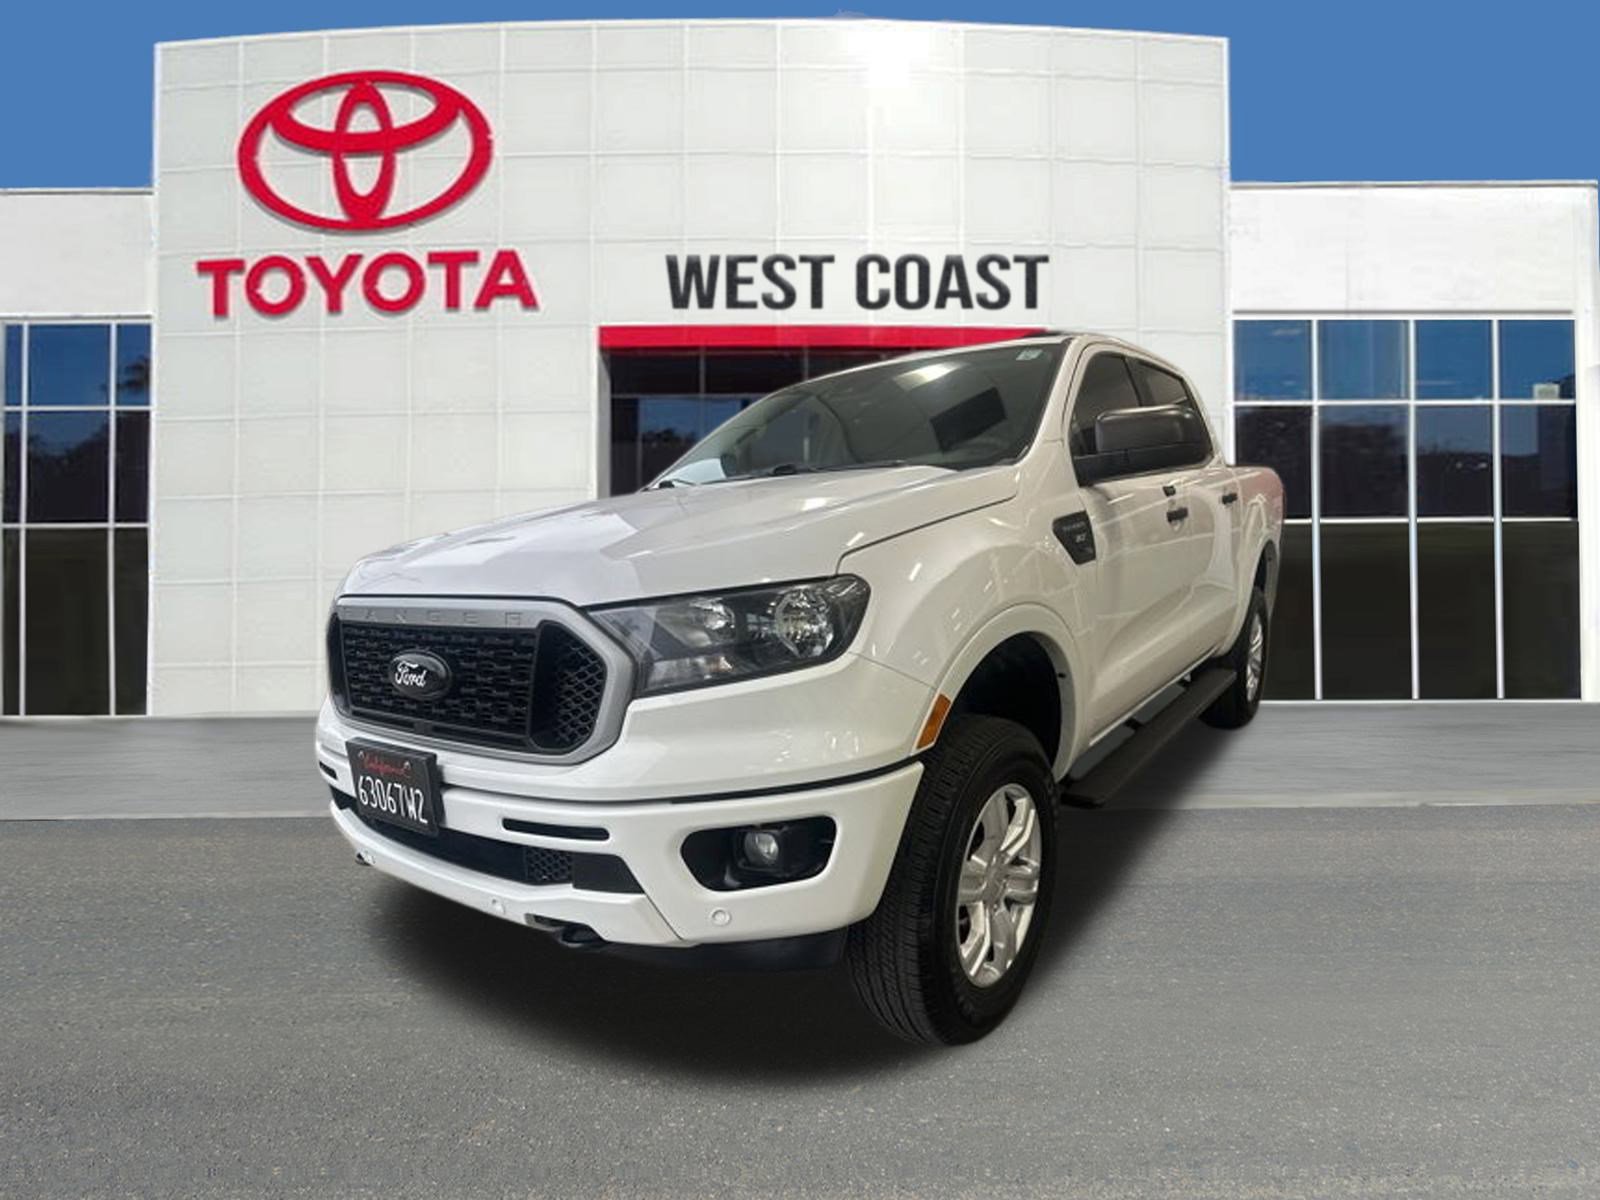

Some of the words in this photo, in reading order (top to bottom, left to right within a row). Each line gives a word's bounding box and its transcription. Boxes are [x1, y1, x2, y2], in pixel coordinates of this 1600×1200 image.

[196, 249, 540, 318] TOYOTA
[666, 253, 835, 310] WEST
[855, 253, 1049, 310] COAST
[395, 660, 427, 688] Ford
